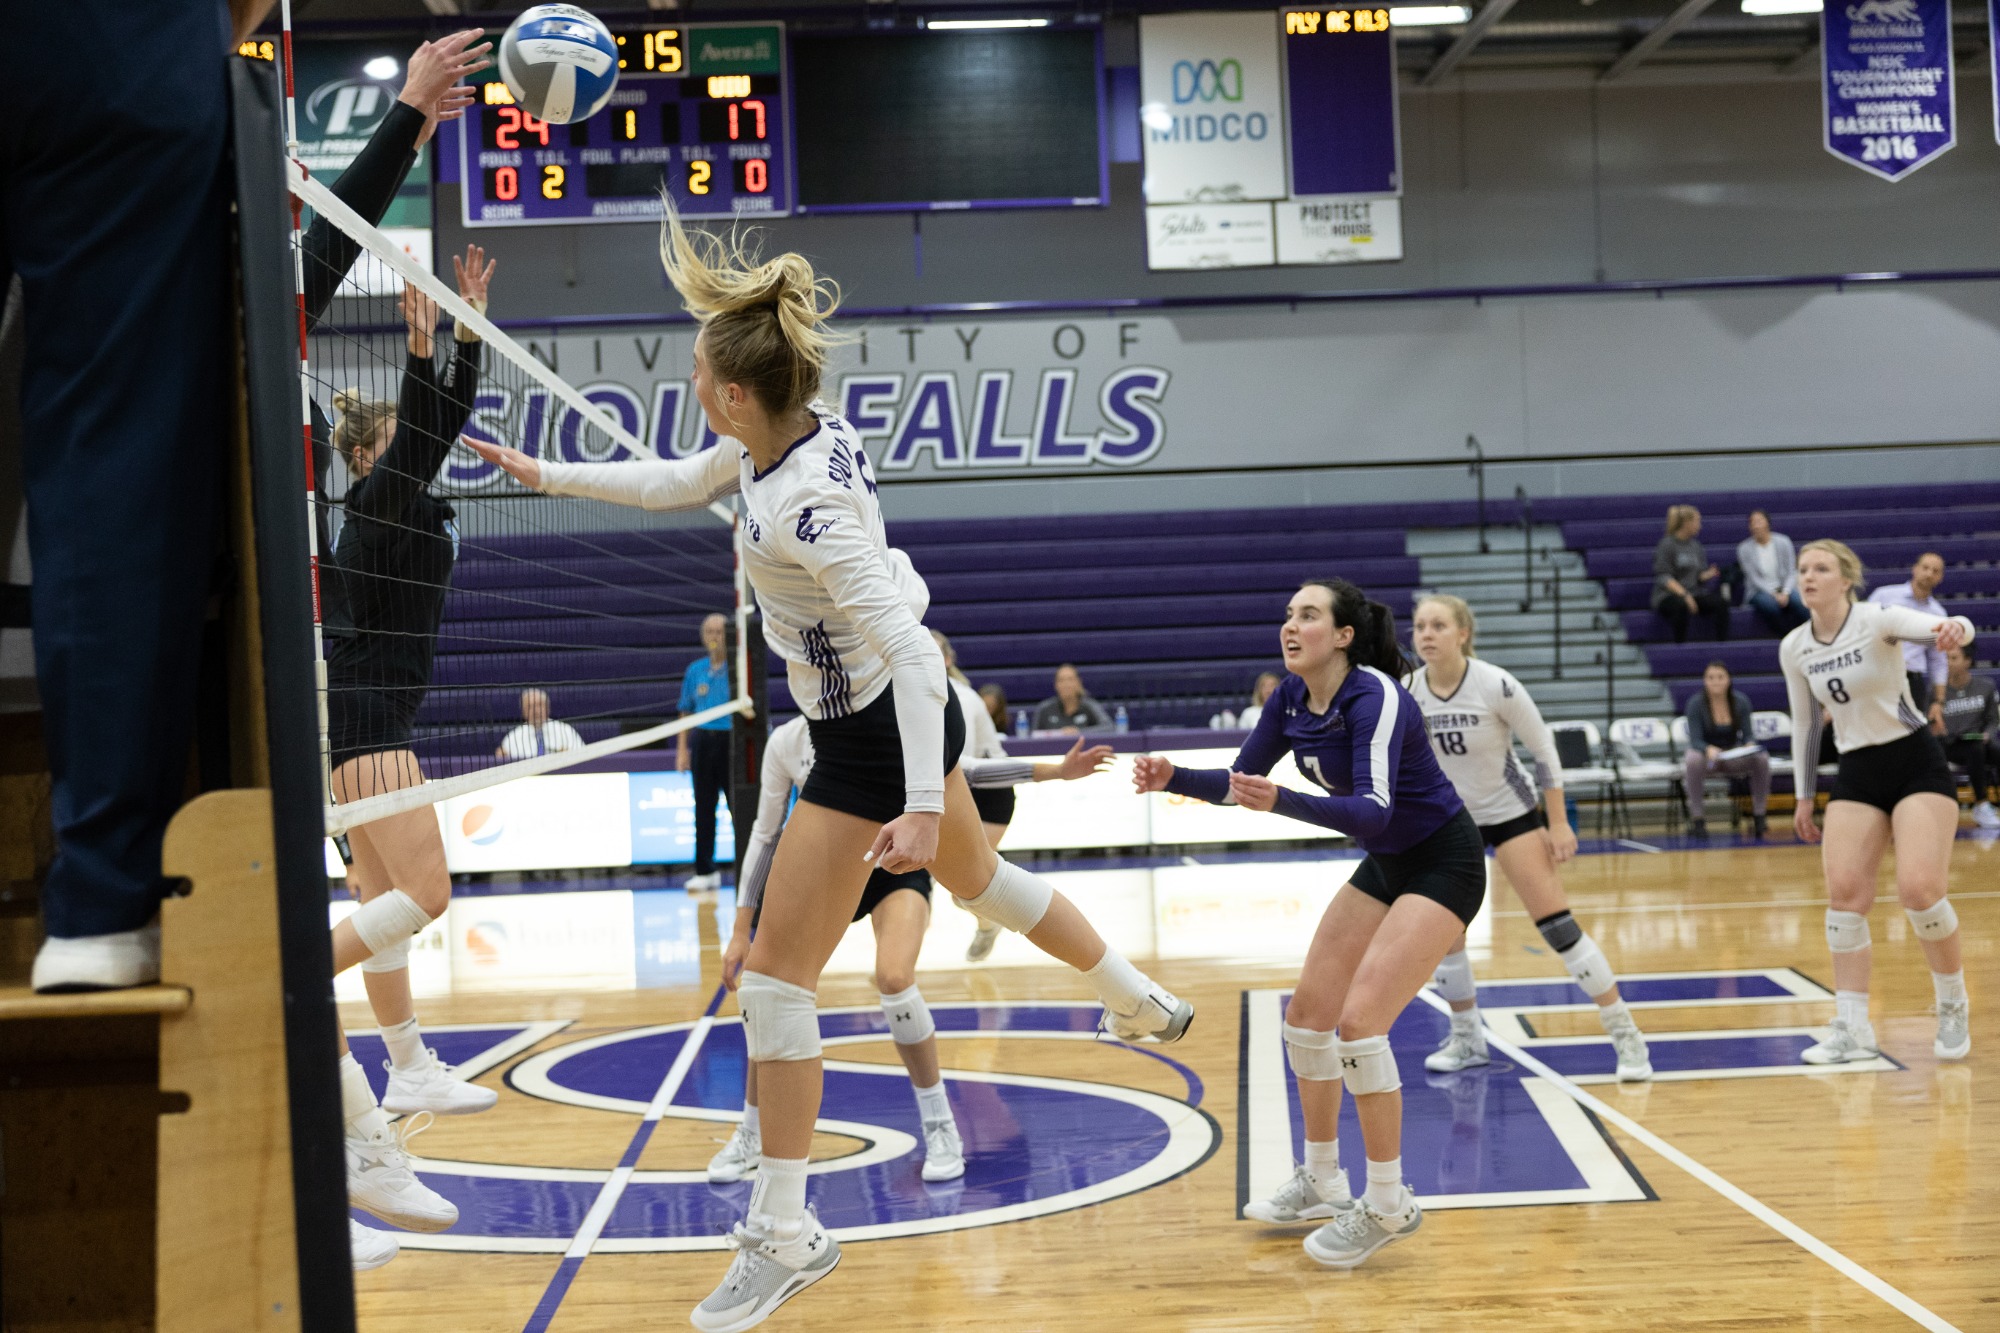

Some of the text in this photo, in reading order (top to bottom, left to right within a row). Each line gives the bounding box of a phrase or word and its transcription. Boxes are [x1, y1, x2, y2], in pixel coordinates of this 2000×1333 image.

[1831, 67, 1945, 86] TOURNAMENT
[609, 89, 648, 107] ERIOD
[1838, 83, 1937, 100] CHAMPIONS
[728, 100, 767, 140] 17
[1855, 101, 1921, 117] WOMEN'S
[495, 107, 550, 149] 24
[624, 109, 637, 140] 1
[1152, 111, 1268, 142] MIDCO
[1831, 114, 1945, 137] BASKETBALL
[479, 151, 523, 167] FOULS
[580, 146, 671, 166] FOUL PLAYER
[728, 144, 772, 160] FOULS
[1861, 136, 1918, 162] 2016
[495, 166, 519, 201] 0
[542, 165, 565, 200] 2
[688, 160, 711, 195] 2
[744, 159, 768, 193] 0
[480, 204, 525, 220] SCORE
[731, 196, 774, 212] SCORE
[1300, 202, 1371, 221] PROTECT
[1052, 322, 1140, 360] OF
[437, 377, 722, 492] SIOU
[840, 364, 1172, 471] FALLS
[1807, 649, 1864, 676] COUGARS
[1827, 678, 1851, 704] 8
[1433, 731, 1468, 756] 18
[1302, 756, 1336, 790] 7
